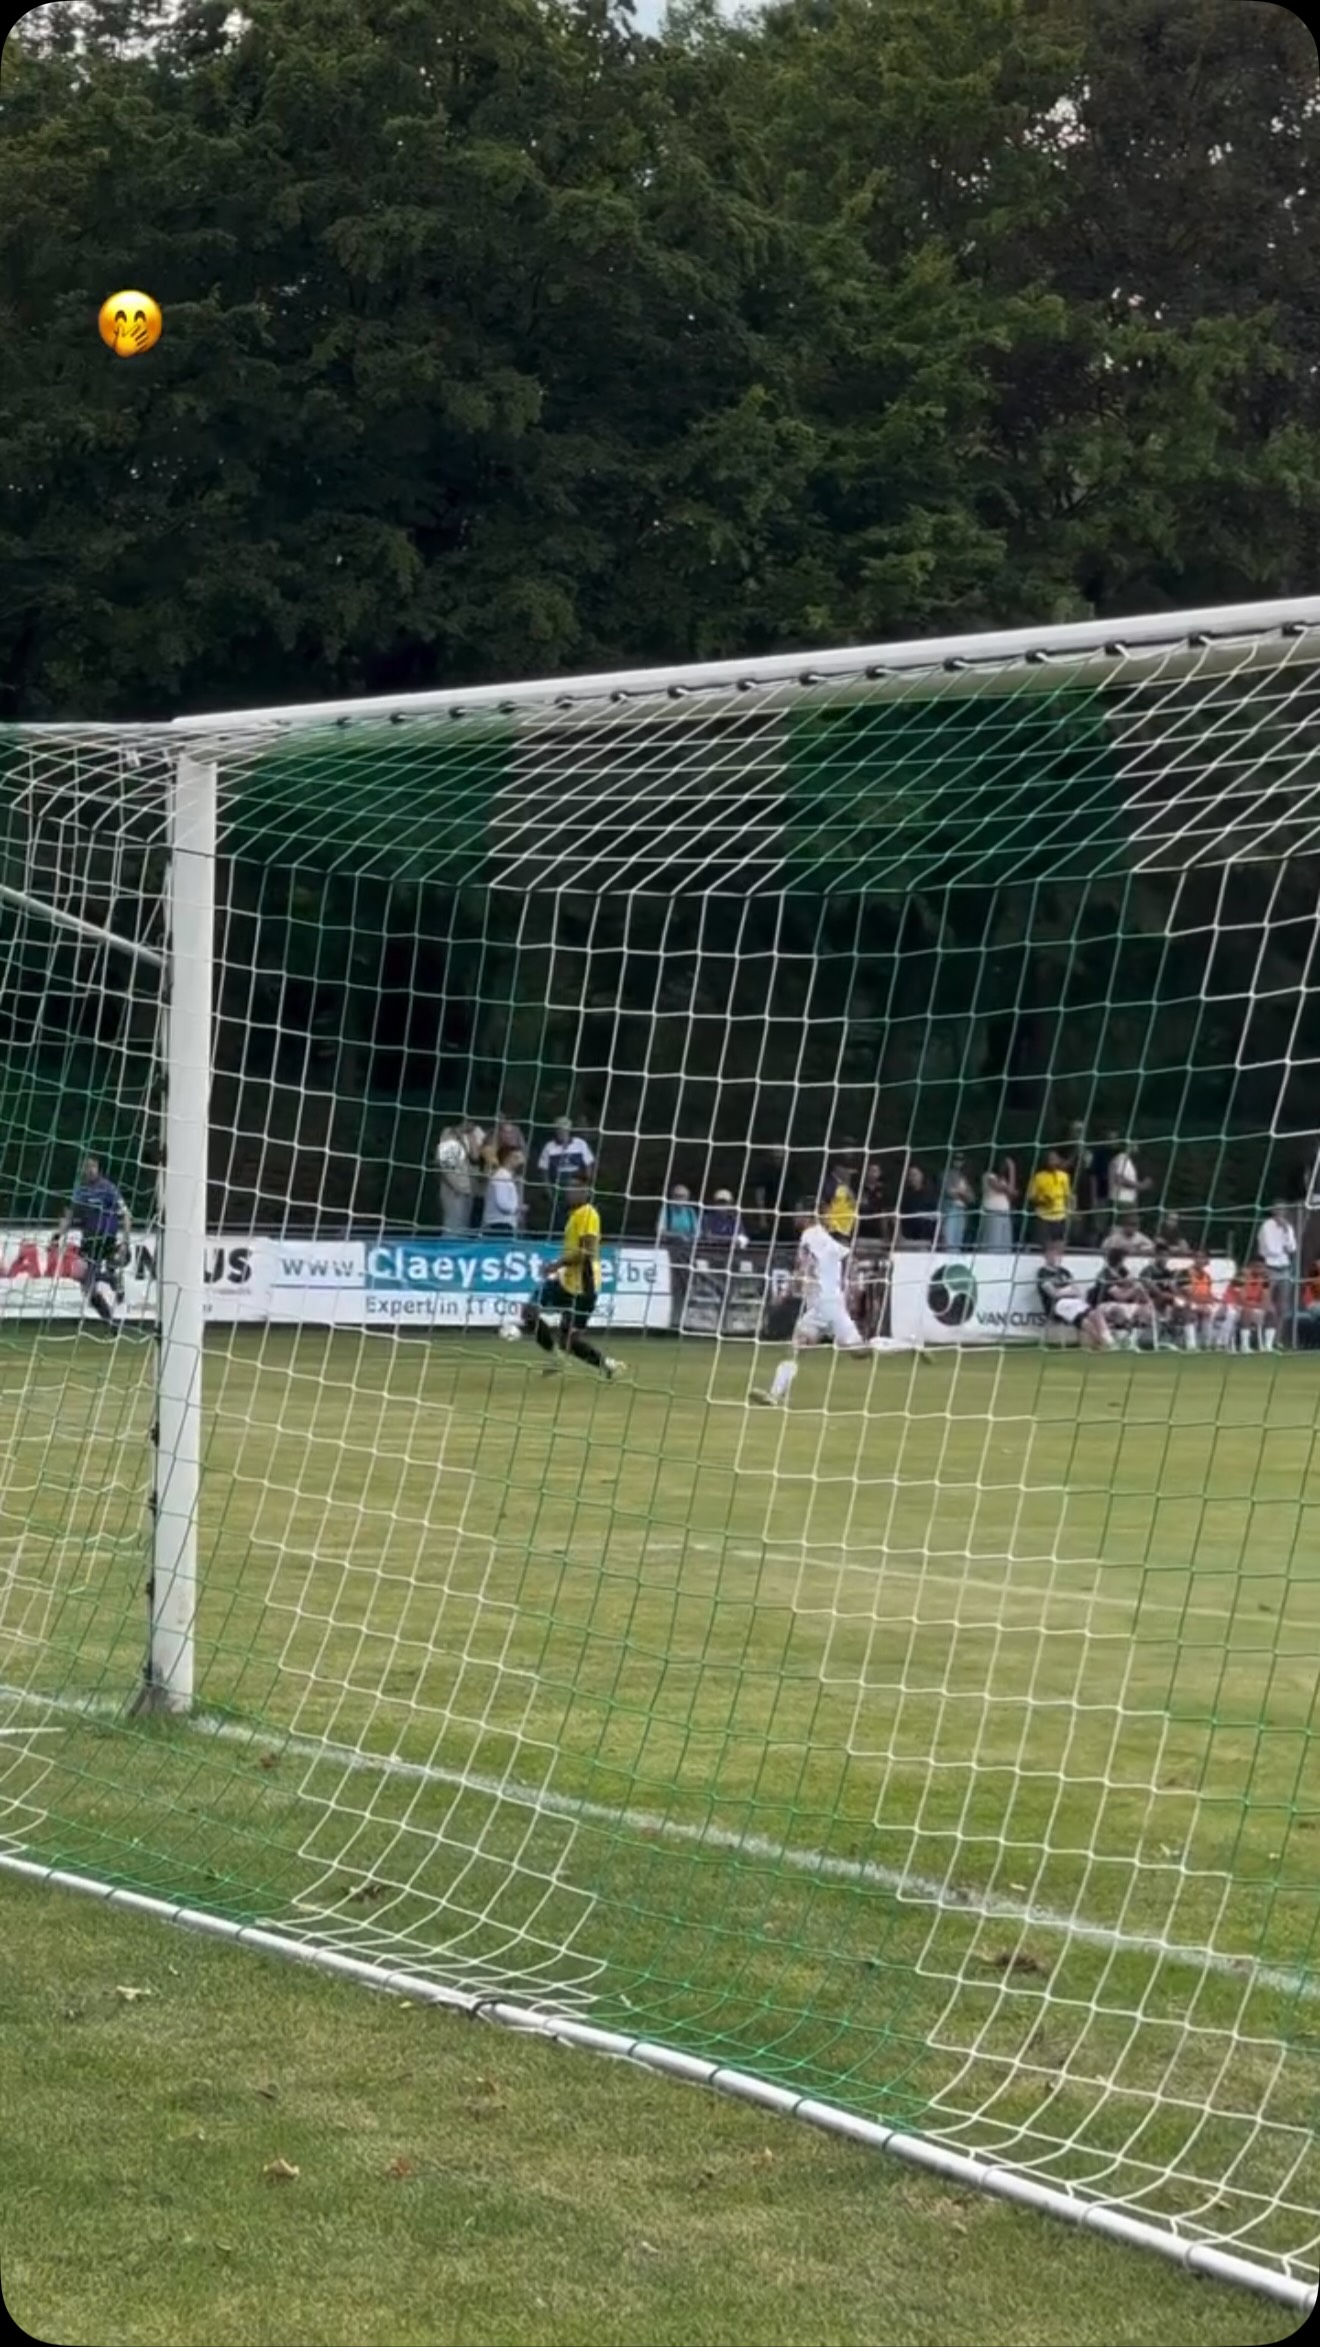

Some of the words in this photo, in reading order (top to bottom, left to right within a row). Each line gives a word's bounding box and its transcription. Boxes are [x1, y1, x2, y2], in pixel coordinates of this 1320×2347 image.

[366, 1296, 434, 1316] Expert
[439, 1298, 457, 1315] in
[976, 1312, 1005, 1326] VAN
[1010, 1312, 1047, 1327] CUTS
